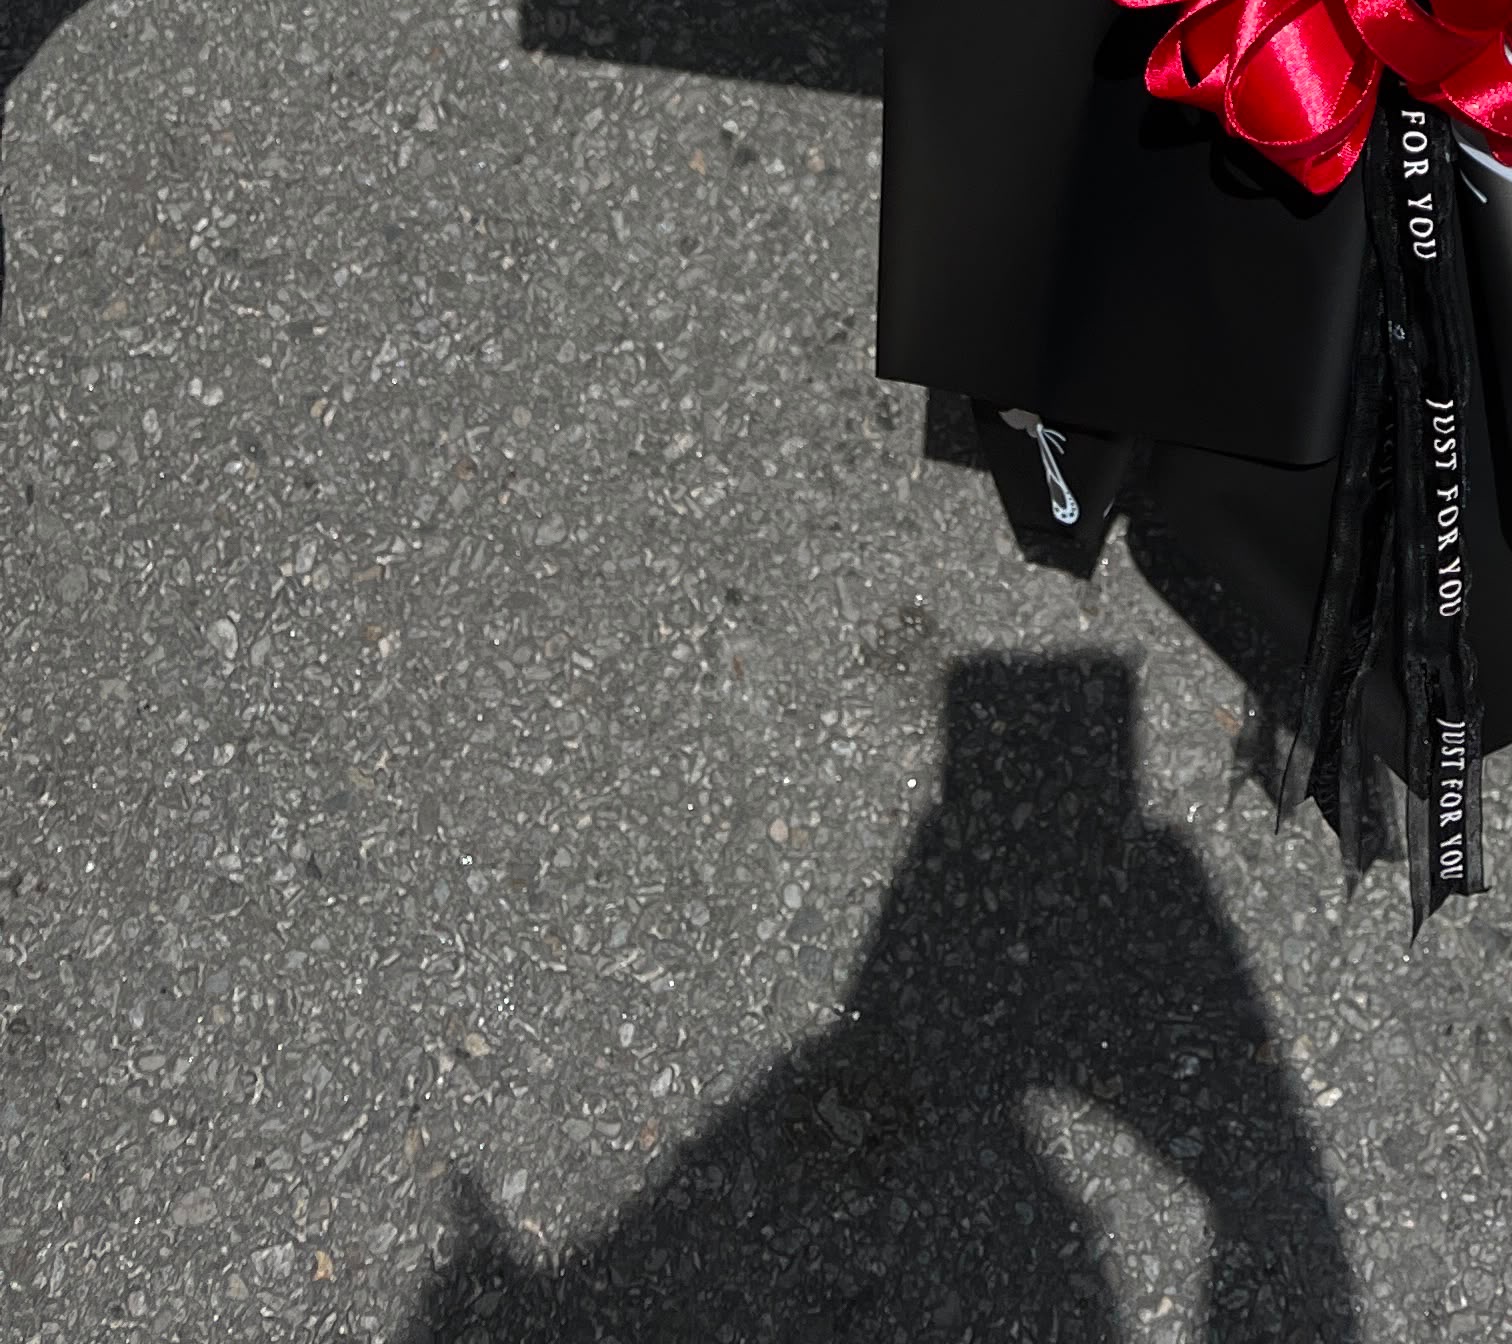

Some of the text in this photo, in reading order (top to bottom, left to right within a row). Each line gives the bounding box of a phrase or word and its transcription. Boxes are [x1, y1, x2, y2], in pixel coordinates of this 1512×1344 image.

[1401, 110, 1437, 260] FOR YOU
[1425, 398, 1463, 617] JUST FOR YOU
[1436, 718, 1466, 880] JUST FOR YOU
